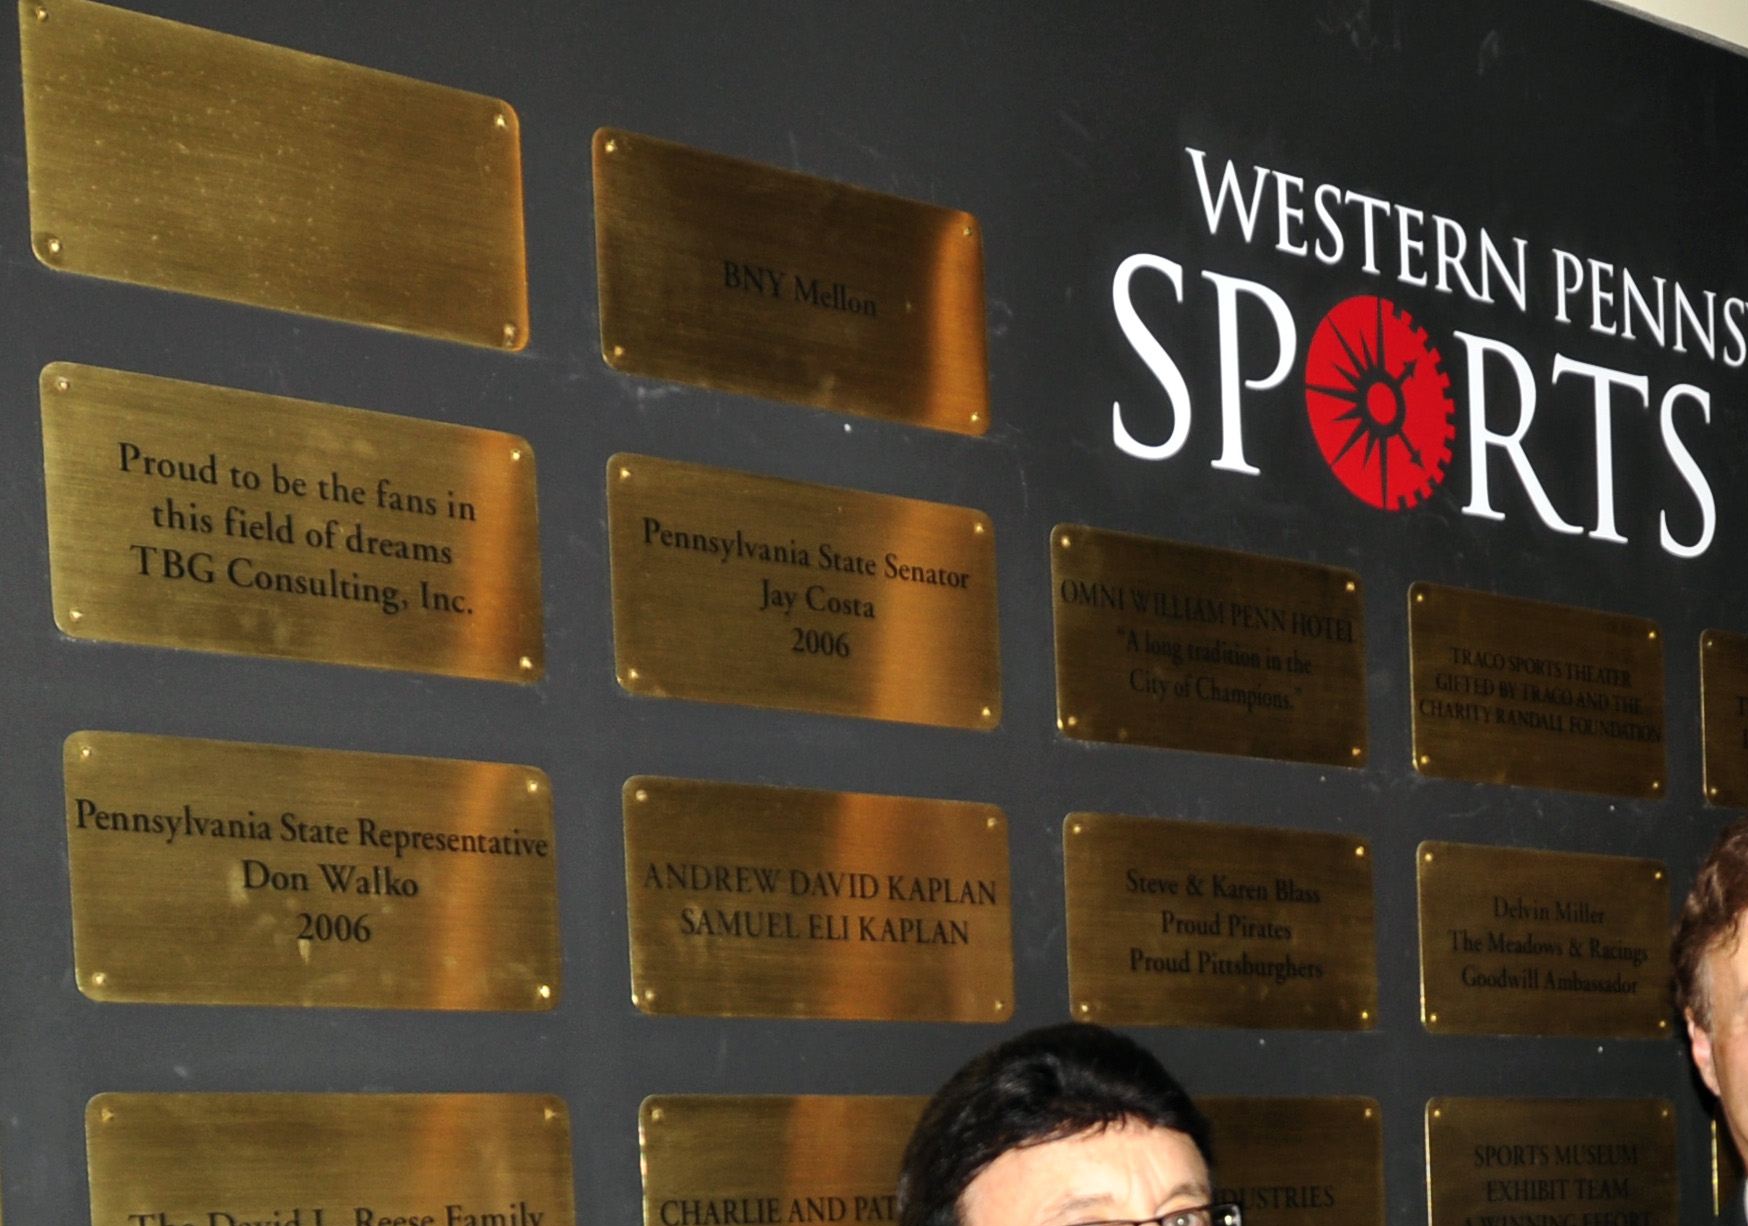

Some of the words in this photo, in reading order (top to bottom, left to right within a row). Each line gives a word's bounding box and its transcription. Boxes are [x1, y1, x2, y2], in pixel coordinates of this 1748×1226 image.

[1186, 148, 1526, 310] WESTERN
[724, 260, 782, 300] BNY
[795, 276, 877, 318] Mellon
[1111, 252, 1718, 560] SPORTS
[119, 442, 218, 485] Proud
[230, 467, 261, 491] to
[272, 463, 306, 498] be
[318, 472, 365, 505] the
[377, 479, 437, 516] fans
[448, 491, 475, 521] in
[152, 498, 213, 534] this
[225, 506, 295, 544] field
[305, 520, 339, 549] of
[346, 523, 452, 564] dreams
[643, 517, 811, 568] Pennsylvania
[819, 544, 876, 576] State
[885, 553, 972, 592] Senator
[130, 545, 215, 584] TBG
[227, 558, 408, 616] Consulting,
[420, 581, 472, 614] Inc.
[759, 578, 798, 617] Jay
[805, 585, 875, 619] Costa
[1061, 580, 1124, 610] OMNI
[1131, 588, 1225, 624] WILLIAM
[1231, 602, 1286, 632] PENN
[1292, 611, 1354, 643] HOTEL
[792, 627, 850, 658] 2006
[1145, 630, 1180, 666] long
[1188, 641, 1260, 668] tradition
[1266, 648, 1282, 673] in
[1287, 650, 1312, 675] the
[1129, 668, 1168, 698] City
[1174, 673, 1192, 698] of
[1453, 647, 1505, 670] TRACO
[1509, 655, 1561, 678] SPORTS
[1566, 663, 1632, 688] THEATER
[1436, 673, 1494, 696] GIFTED
[1500, 680, 1516, 698] BY
[1521, 683, 1573, 705] TRACO
[1576, 692, 1609, 712] AND
[1613, 697, 1642, 714] THE
[1420, 699, 1496, 723] CHARITY
[1497, 708, 1563, 732] RANDALL
[1569, 715, 1661, 742] FOUNDATION
[76, 799, 272, 844] Pennsylvania
[280, 812, 349, 845] State
[357, 818, 548, 859] Representative
[242, 860, 310, 892] Don
[318, 864, 419, 898] Walko
[644, 863, 780, 893] ANDREW
[790, 869, 879, 899] DAVID
[888, 875, 996, 905] KAPLAN
[1127, 869, 1179, 895] Steve
[1185, 874, 1204, 898] &
[1212, 874, 1268, 902] Karen
[1274, 878, 1321, 904] Blass
[295, 911, 374, 945] 2006
[677, 908, 800, 939] SAMUEL
[809, 914, 848, 941] ELI
[859, 916, 968, 945] KAPLAN
[1162, 910, 1221, 936] Proud
[1228, 913, 1291, 940] Pirates
[1493, 896, 1550, 921] Delvin
[1555, 901, 1605, 924] Miller
[1448, 930, 1483, 954] The
[1487, 931, 1563, 956] Meadows
[1569, 938, 1583, 959] &
[1130, 948, 1192, 974] Proud
[1198, 950, 1323, 985] Pittsburghers
[1461, 965, 1539, 989] Goodwill
[1544, 970, 1638, 994] Ambassador
[1475, 1145, 1549, 1167] SPORTS
[1556, 1145, 1638, 1166] MUSEUM
[789, 1197, 847, 1223] AND
[1214, 1185, 1335, 1209] DUSTRIES
[1487, 1180, 1568, 1202] EXHIBIT
[1576, 1179, 1630, 1200] TEAM
